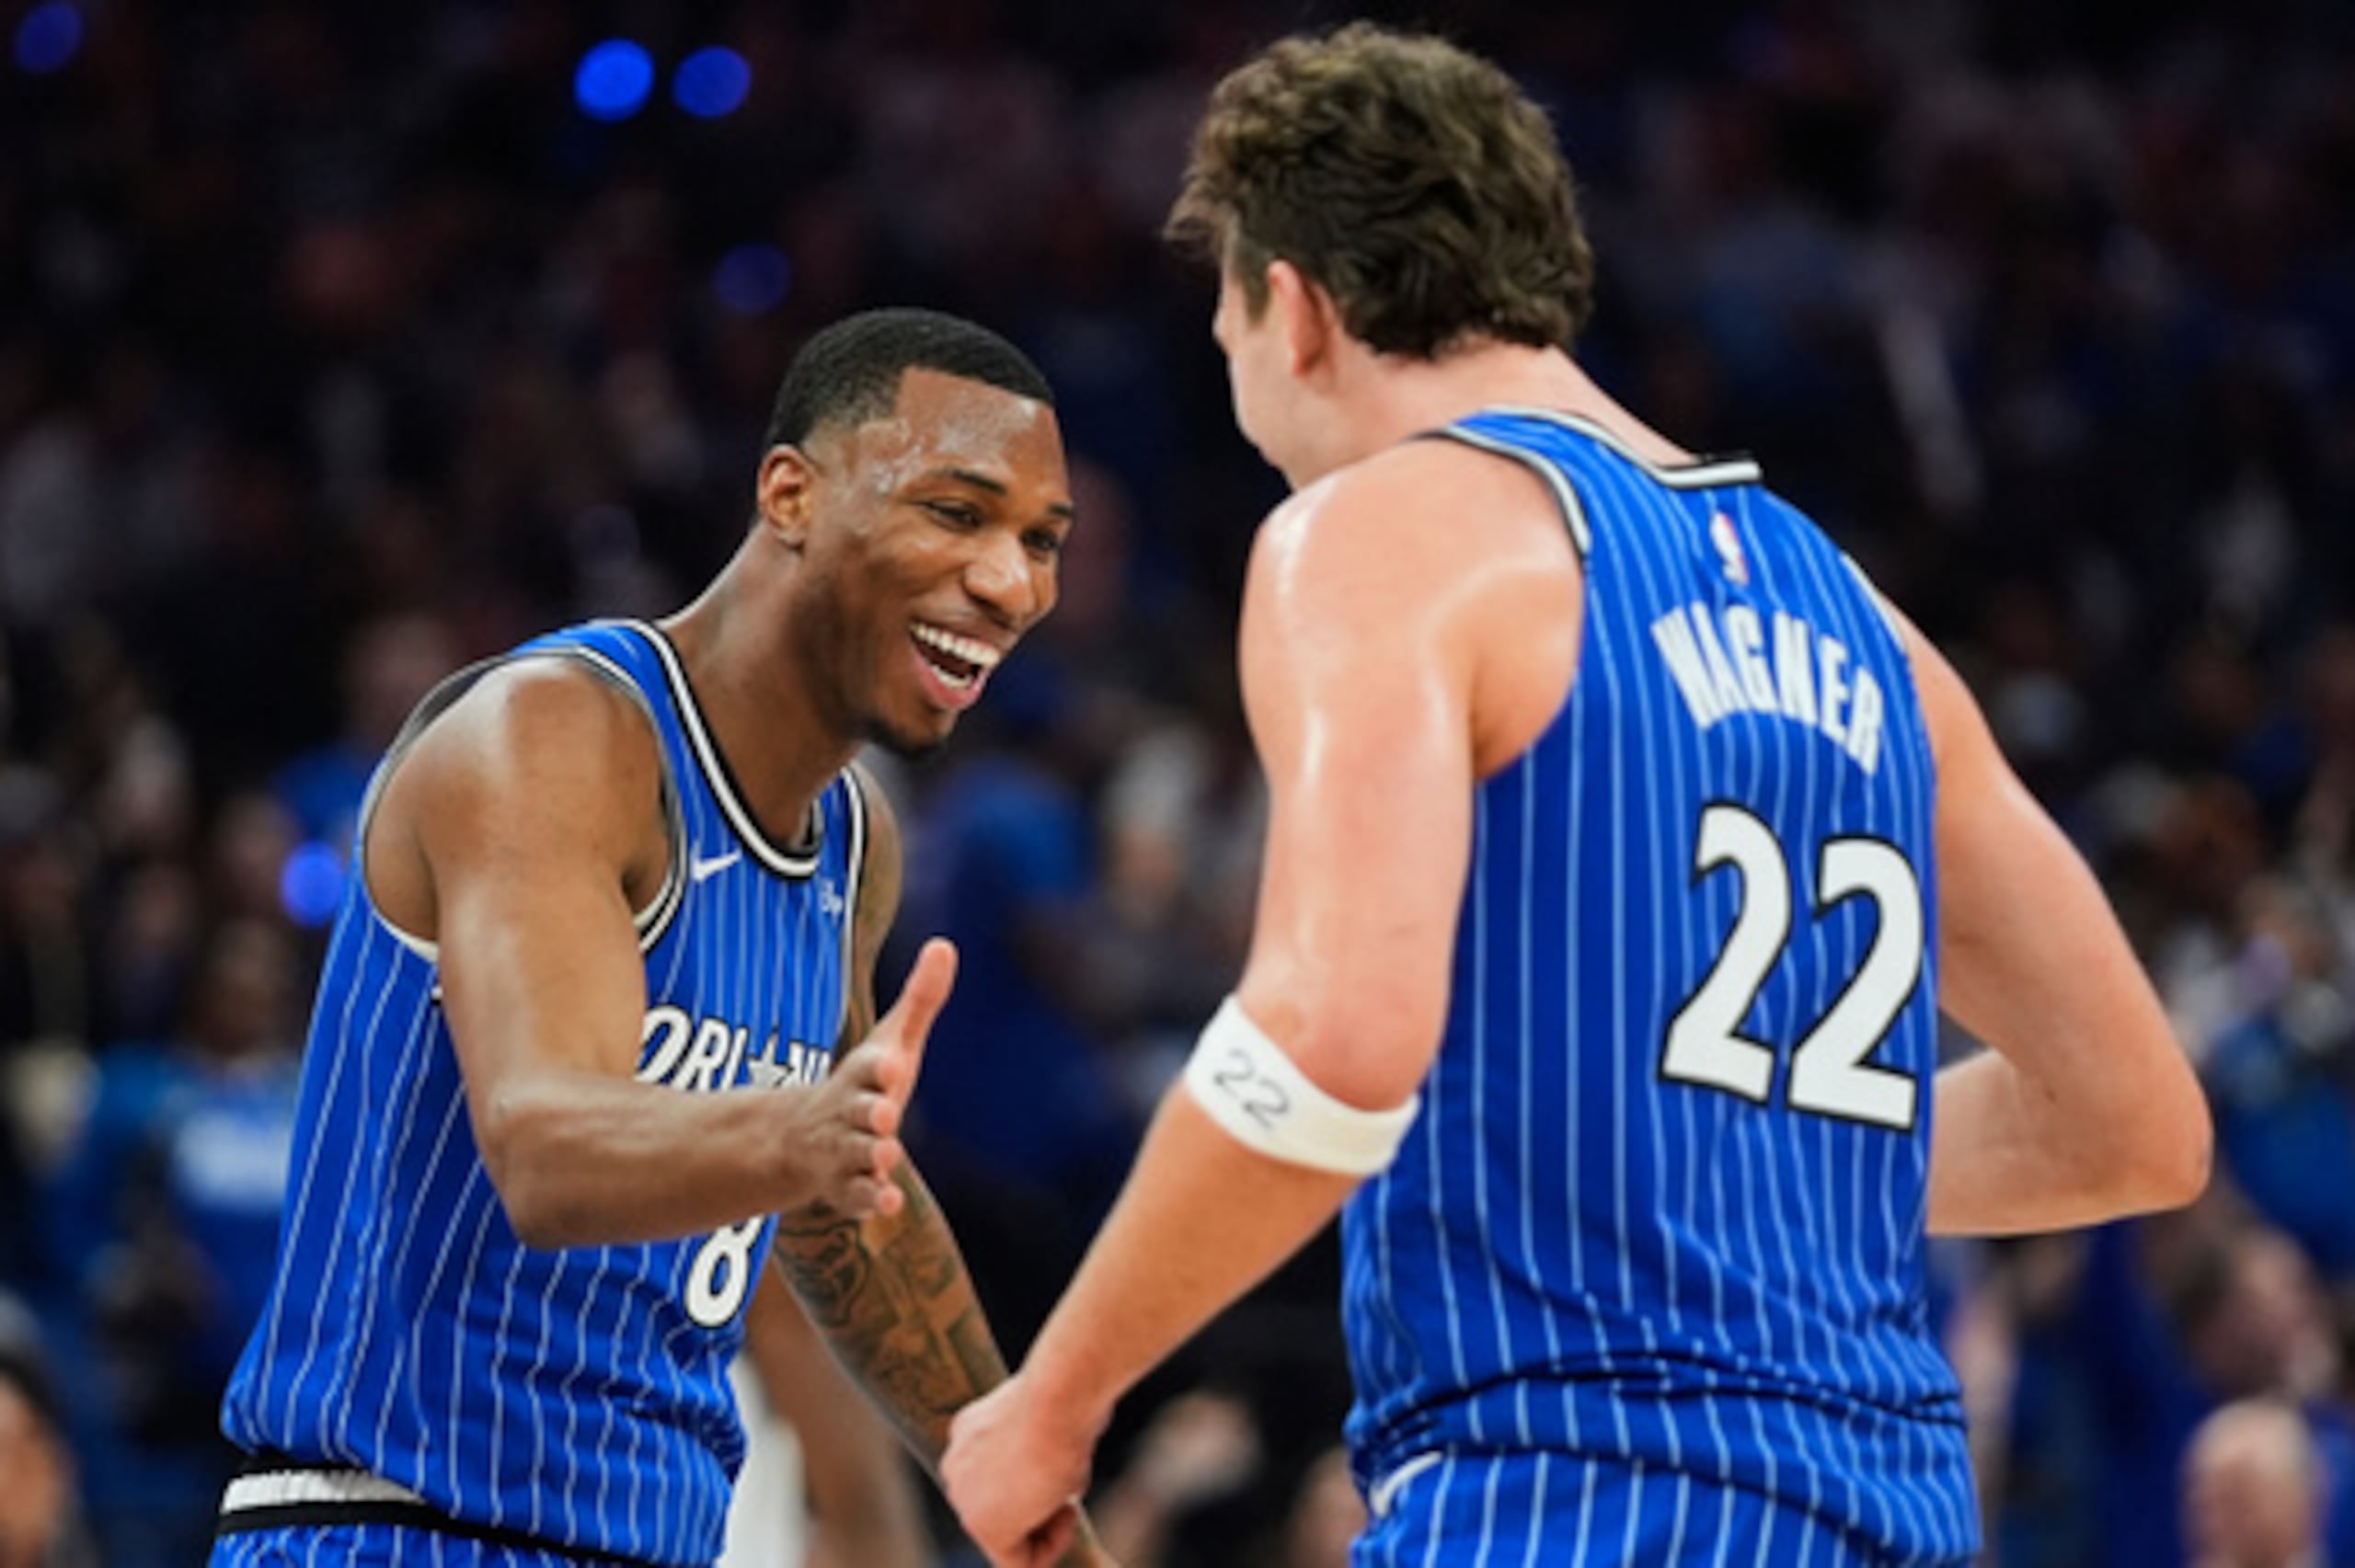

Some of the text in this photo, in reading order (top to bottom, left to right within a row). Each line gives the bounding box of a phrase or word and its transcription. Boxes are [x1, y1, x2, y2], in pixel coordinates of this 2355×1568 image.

[1650, 601, 1883, 775] WAGNER
[1659, 800, 1924, 1133] 22
[1213, 1047, 1290, 1130] 22
[684, 1214, 765, 1327] 8
